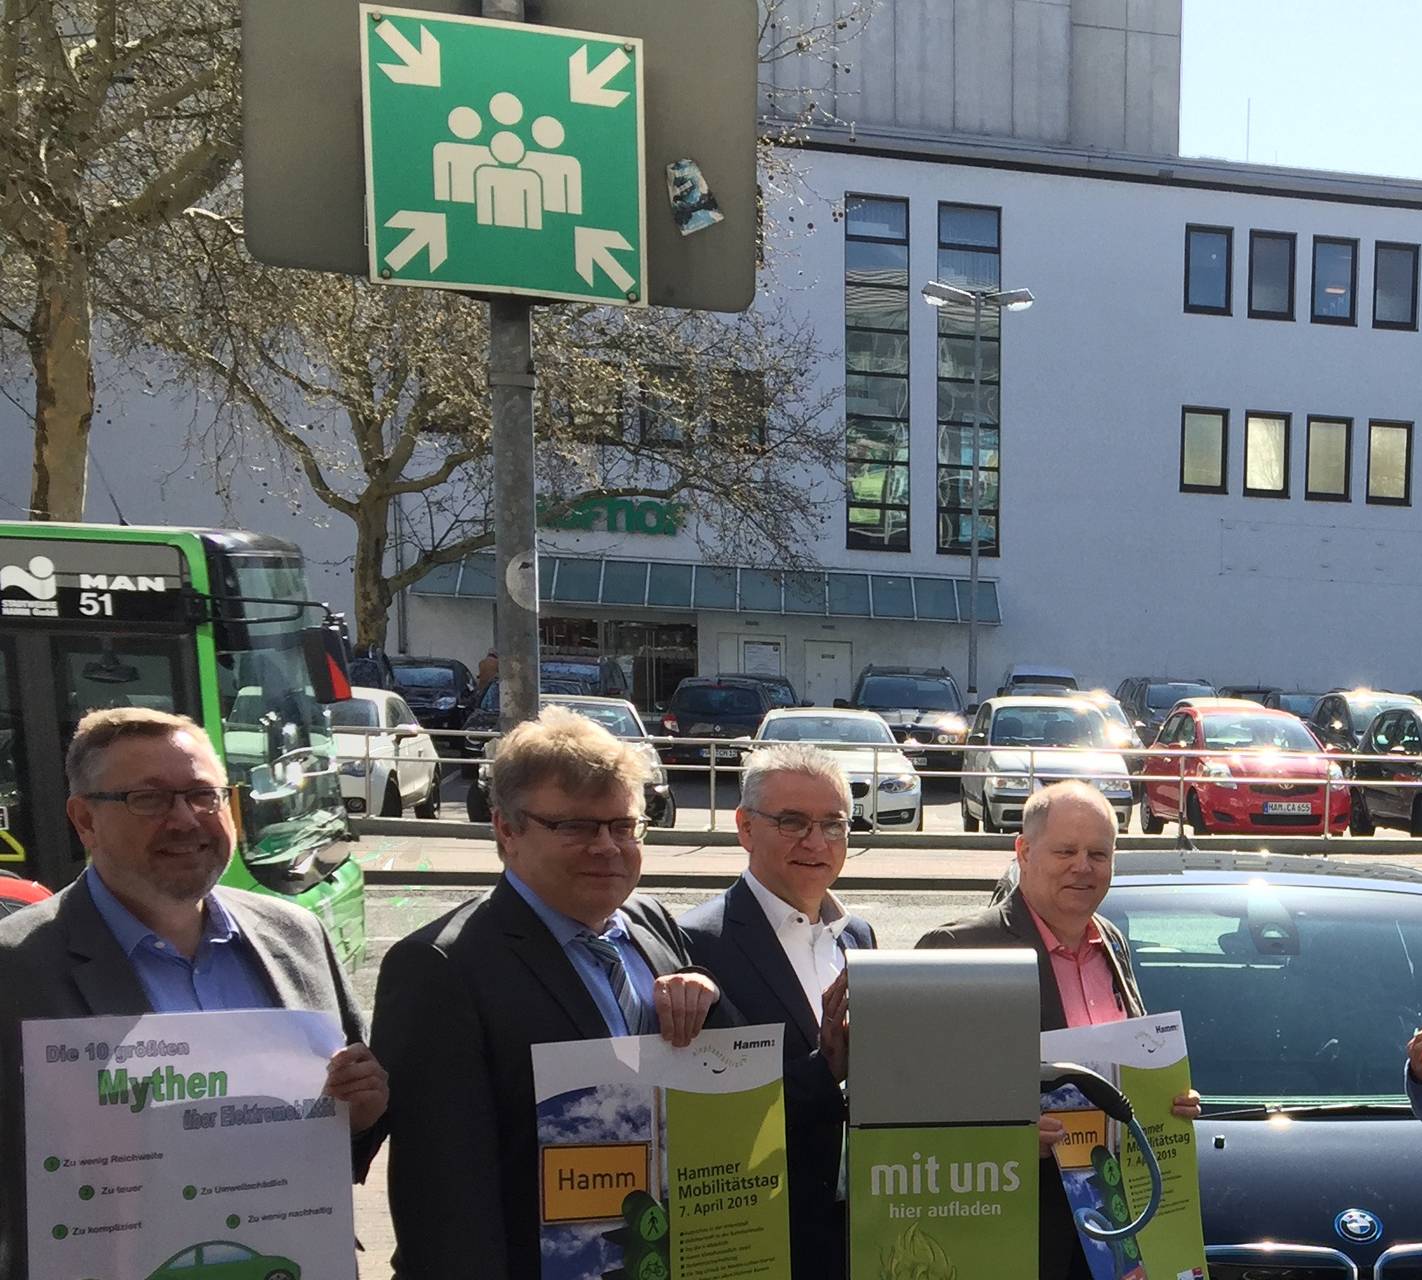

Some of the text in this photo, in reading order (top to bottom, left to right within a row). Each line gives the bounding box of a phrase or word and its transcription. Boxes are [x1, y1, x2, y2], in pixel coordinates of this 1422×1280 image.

[80, 573, 166, 592] MAN
[79, 592, 113, 616] 51
[46, 1039, 190, 1064] Die 10 größten
[733, 1039, 775, 1051] Hamm:
[97, 1065, 228, 1113] Mythen
[1062, 1130, 1098, 1146] amm
[1156, 1148, 1177, 1161] 2019
[557, 1168, 636, 1192] Hamm
[677, 1161, 742, 1182] Hammer
[870, 1152, 1022, 1196] mit uns
[678, 1174, 779, 1201] Mobilitätstag
[679, 1194, 758, 1218] 7. April 2019
[889, 1201, 1002, 1220] hier aufladen
